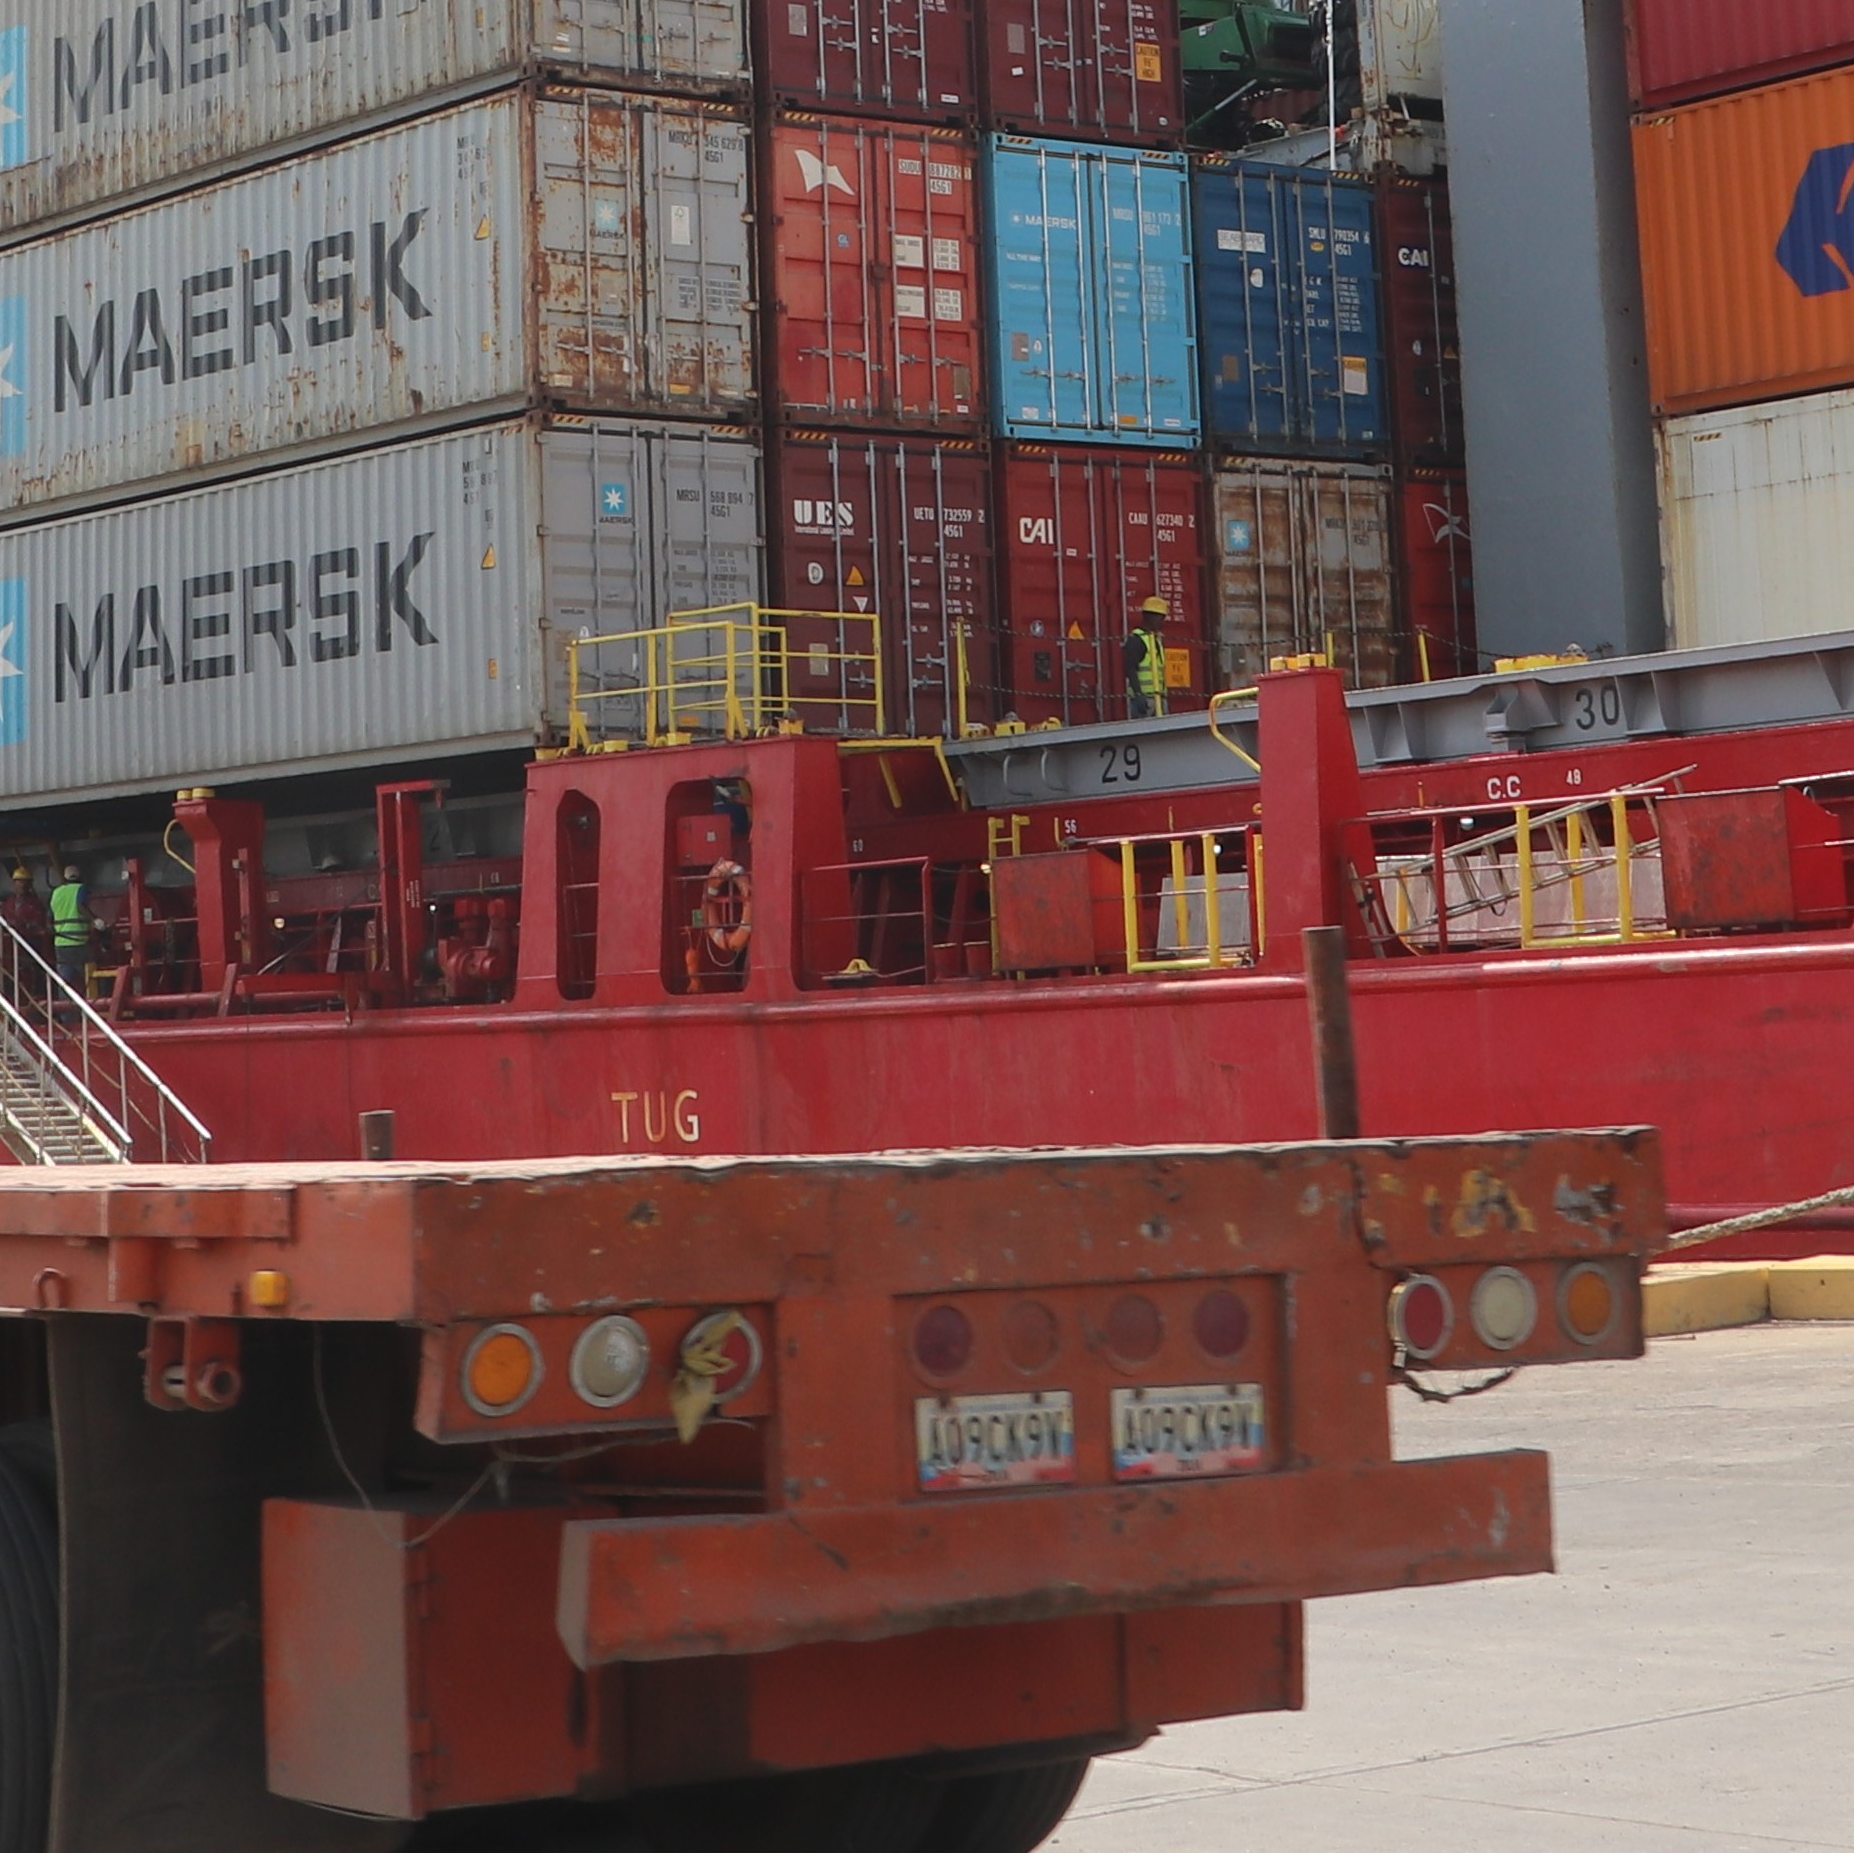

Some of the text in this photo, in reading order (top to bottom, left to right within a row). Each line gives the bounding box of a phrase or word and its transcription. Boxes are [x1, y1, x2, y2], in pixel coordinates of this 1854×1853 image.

[1024, 215, 1077, 231] MAERSK
[1217, 230, 1266, 245] SEABARD
[1397, 247, 1429, 267] CAI
[53, 207, 433, 414] MAERSK
[676, 488, 701, 503] MRSU
[709, 504, 732, 518] 45G1
[793, 499, 855, 527] UES
[913, 506, 986, 524] UETU 732559 2
[1128, 511, 1195, 529] CAAU 627340 2
[943, 523, 964, 538] 45G1
[1018, 516, 1055, 545] CAI
[1156, 529, 1176, 543] 45G1
[53, 530, 440, 703] MAERSK
[1574, 684, 1621, 732] 30
[1099, 744, 1142, 785] 29
[1486, 768, 1582, 800] C.C 48
[1064, 819, 1078, 834] 56
[609, 1089, 702, 1145] TUG
